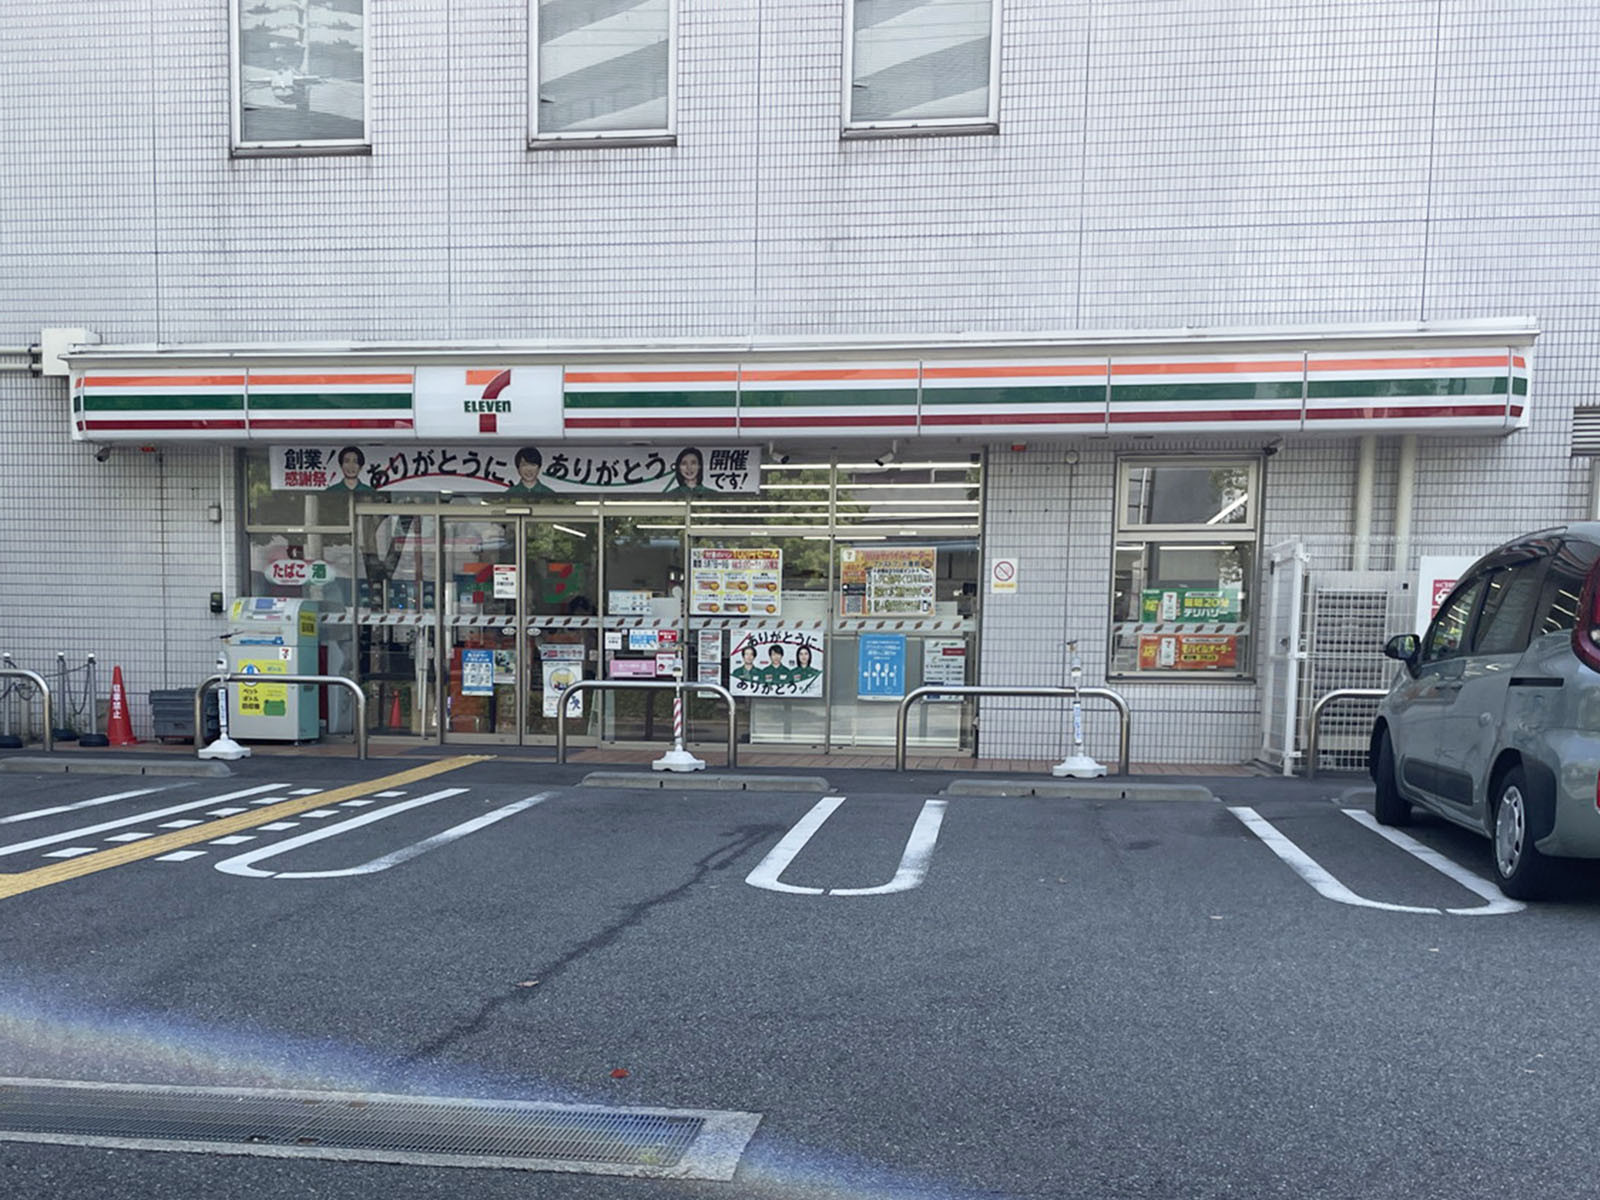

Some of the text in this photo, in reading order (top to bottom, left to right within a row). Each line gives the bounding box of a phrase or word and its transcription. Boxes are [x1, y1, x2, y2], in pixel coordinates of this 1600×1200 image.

[710, 450, 749, 470] 開催
[284, 471, 337, 487] 感謝祭!
[710, 473, 748, 490] です!
[273, 563, 327, 579] たばこ 酒
[1184, 608, 1228, 617] デリバリー
[112, 683, 122, 720] 駐車禁止
